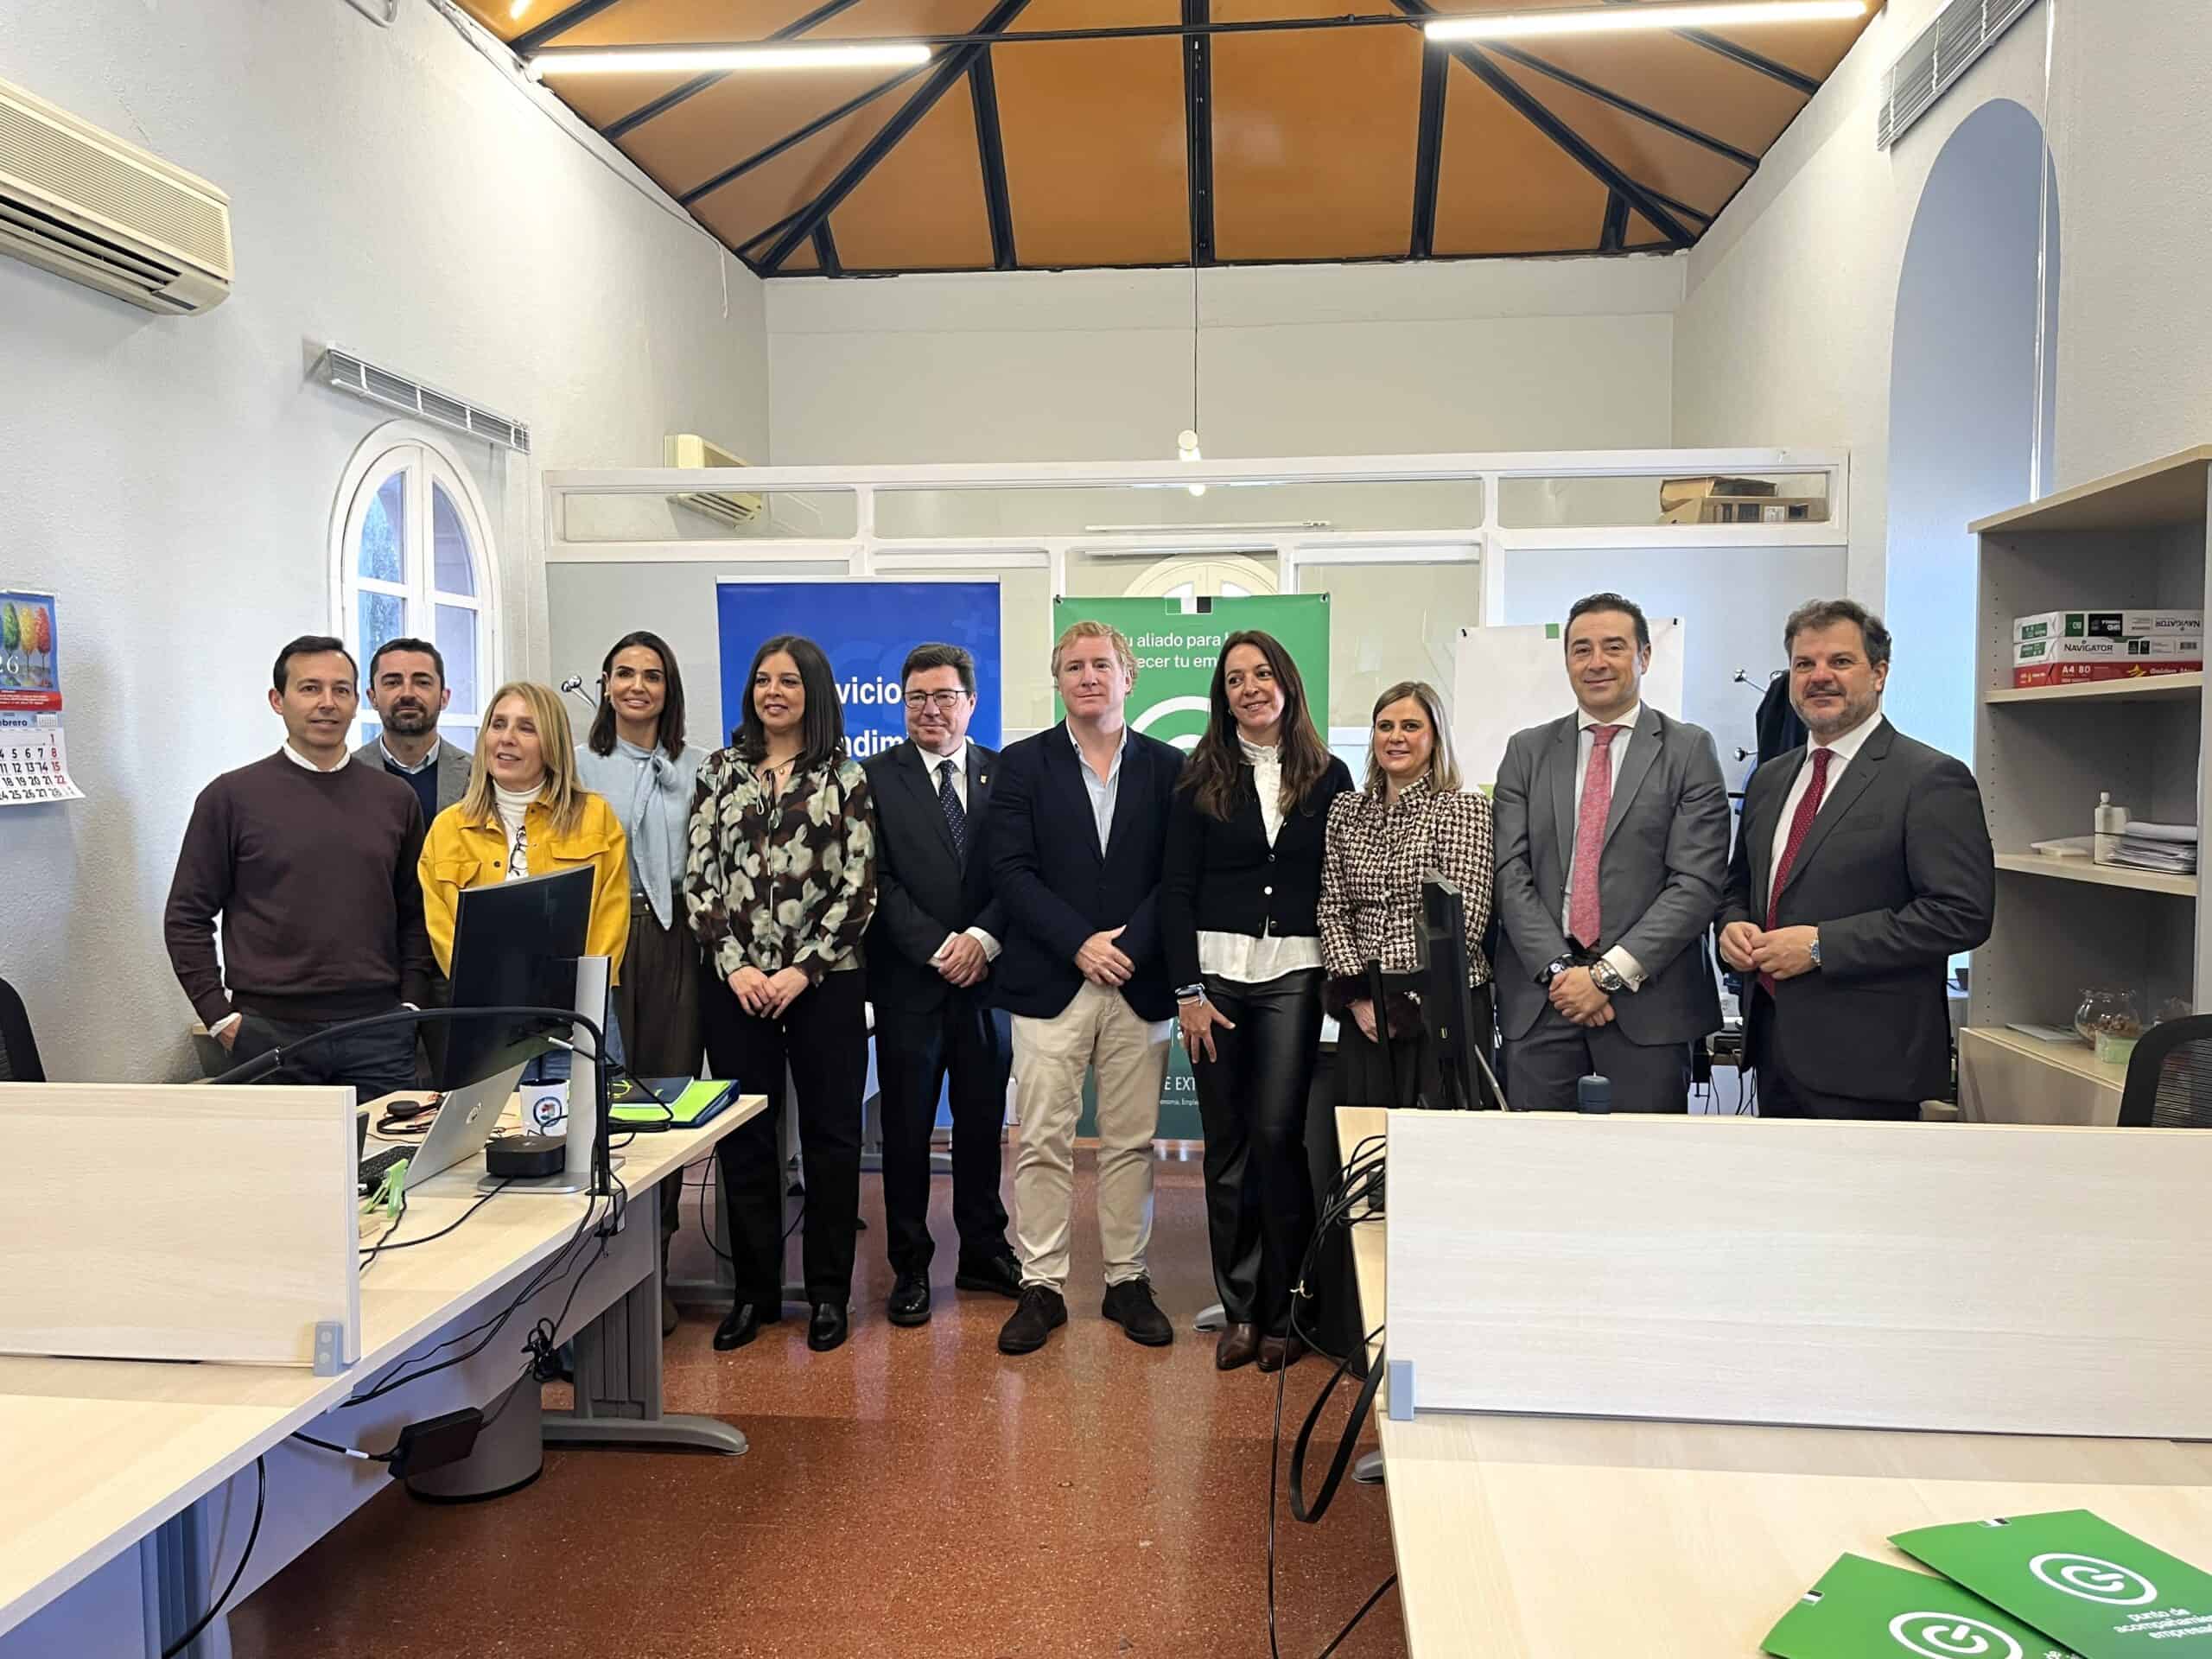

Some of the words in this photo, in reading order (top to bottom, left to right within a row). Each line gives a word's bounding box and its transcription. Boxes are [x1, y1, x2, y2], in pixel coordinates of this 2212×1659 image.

[1137, 632, 1183, 647] aliado
[1187, 636, 1221, 649] para
[2064, 640, 2113, 652] NAVIGATOR
[1136, 657, 1169, 669] ecer
[1175, 655, 1189, 668] tu
[1193, 658, 1217, 668] em
[2063, 665, 2075, 674] A4
[2079, 665, 2090, 674] 80
[836, 677, 902, 705] vicio
[50, 734, 55, 744] 1
[12, 748, 18, 759] 5
[25, 747, 31, 759] 6
[38, 747, 43, 759] 7
[51, 747, 57, 758] 8
[12, 762, 22, 773] 12
[25, 762, 35, 772] 13
[35, 761, 48, 774] 14
[51, 761, 60, 772] 15
[3, 777, 14, 787] 18
[16, 776, 27, 786] 19
[29, 776, 41, 786] 20
[42, 775, 53, 785] 21
[54, 775, 67, 785] 22
[9, 790, 22, 799] 25
[22, 789, 35, 799] 26
[36, 788, 48, 798] 27
[1175, 1076, 1196, 1091] EXT
